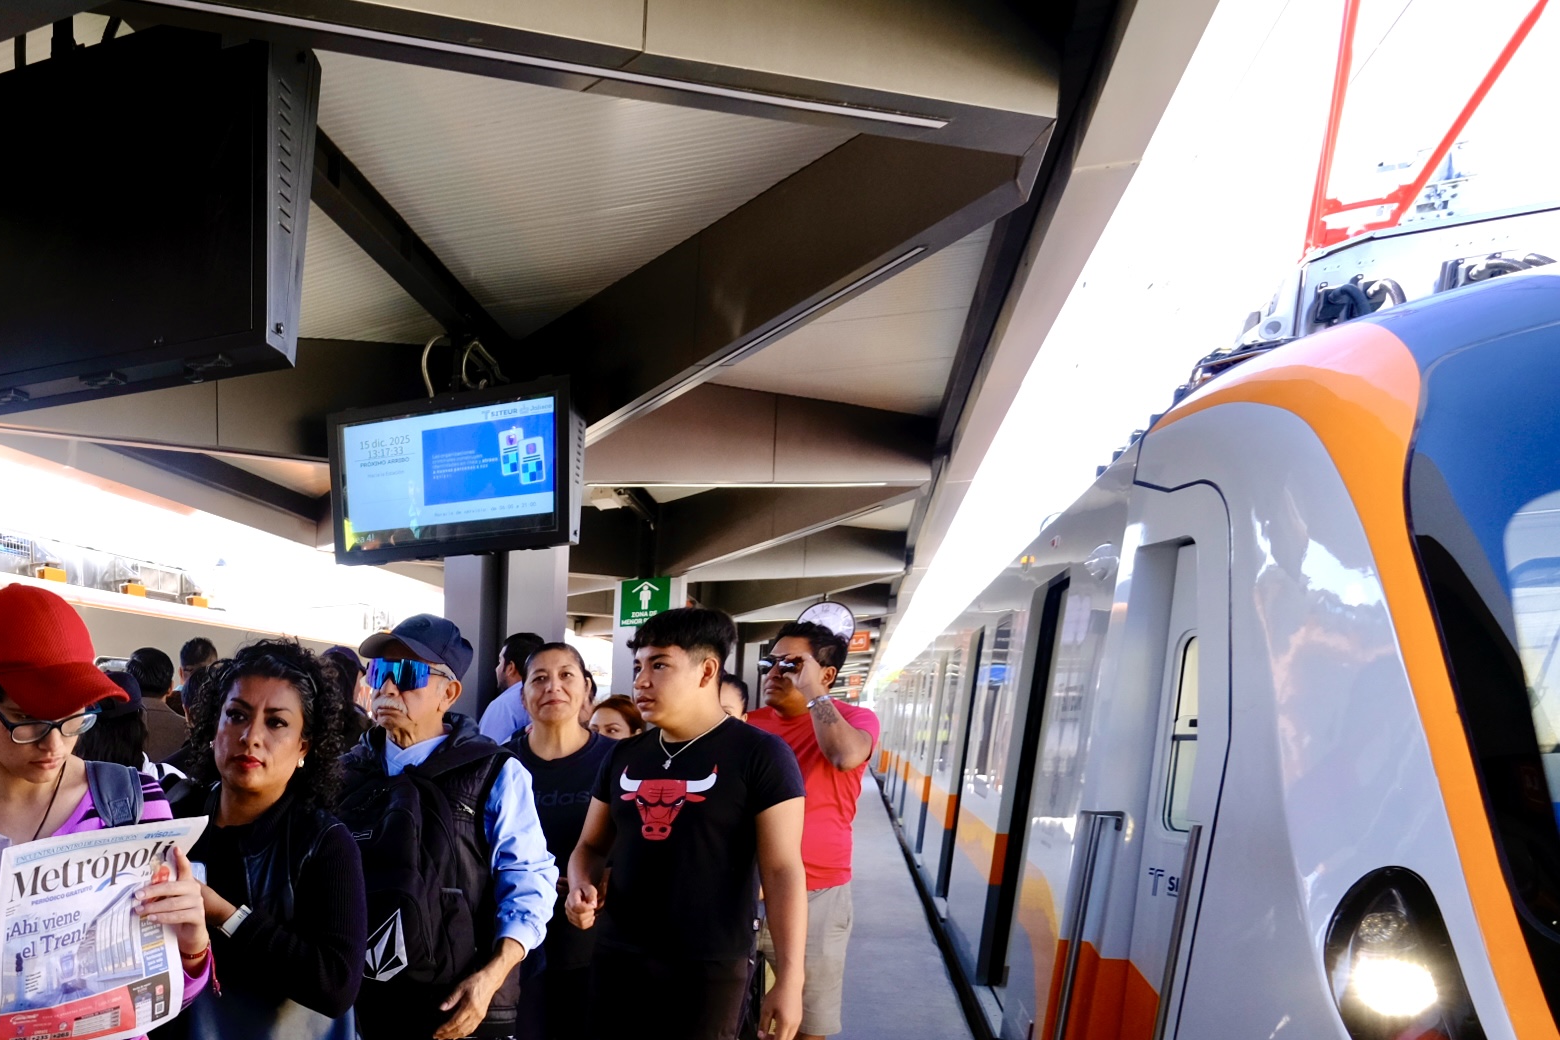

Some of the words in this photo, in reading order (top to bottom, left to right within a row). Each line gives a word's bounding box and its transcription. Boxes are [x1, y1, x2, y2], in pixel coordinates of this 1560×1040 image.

[490, 408, 518, 417] SITEUR
[360, 441, 370, 450] 15
[389, 435, 411, 446] 2025
[368, 446, 404, 459] 13:17:33
[621, 618, 643, 626] MENOR
[535, 790, 590, 806] idas
[144, 830, 169, 840] aviso
[8, 840, 176, 903] Metrópoli
[31, 893, 65, 906] PERIÓDICO
[6, 917, 38, 942] ¡Ahí
[42, 910, 81, 930] viene
[22, 941, 37, 959] el
[40, 923, 87, 955] Tren!
